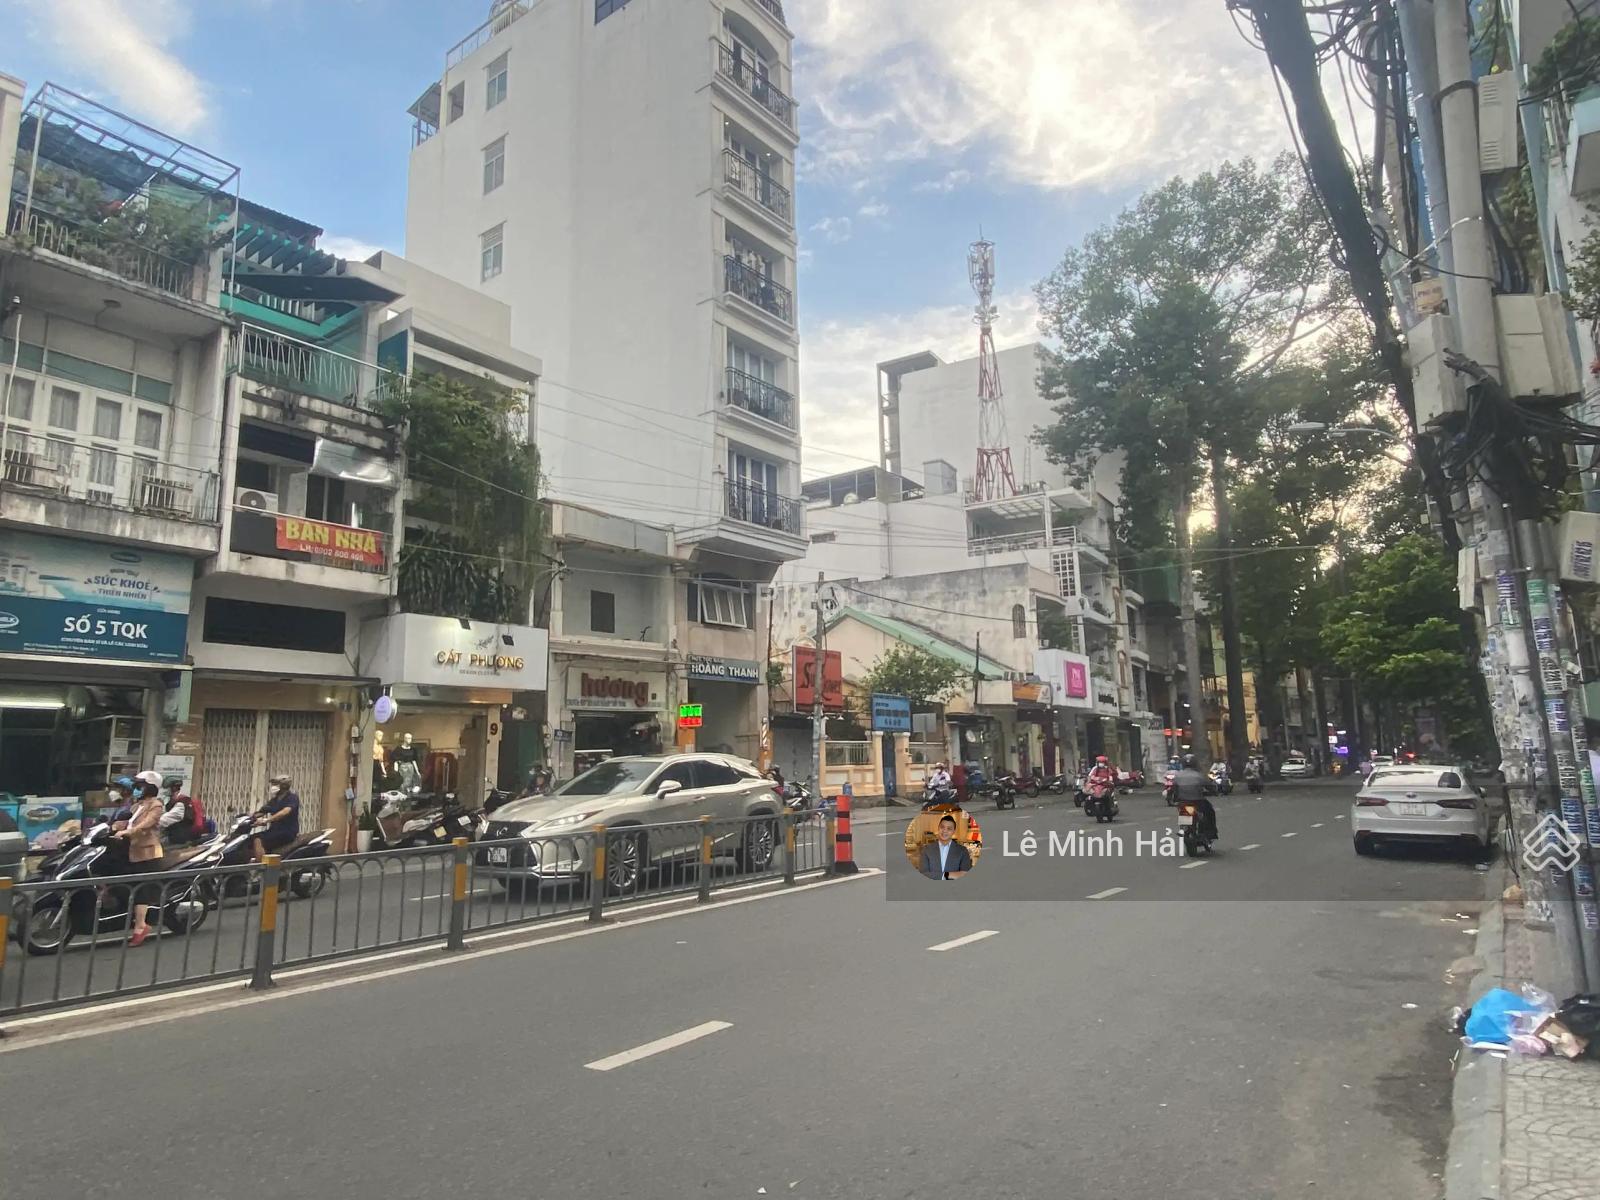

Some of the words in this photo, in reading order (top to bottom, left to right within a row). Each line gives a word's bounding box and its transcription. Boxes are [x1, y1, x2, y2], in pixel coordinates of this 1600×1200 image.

[63, 613, 91, 633] SỐ
[95, 620, 107, 635] 5
[110, 620, 149, 639] TQK
[728, 666, 759, 678] THANH
[490, 722, 498, 735] 9
